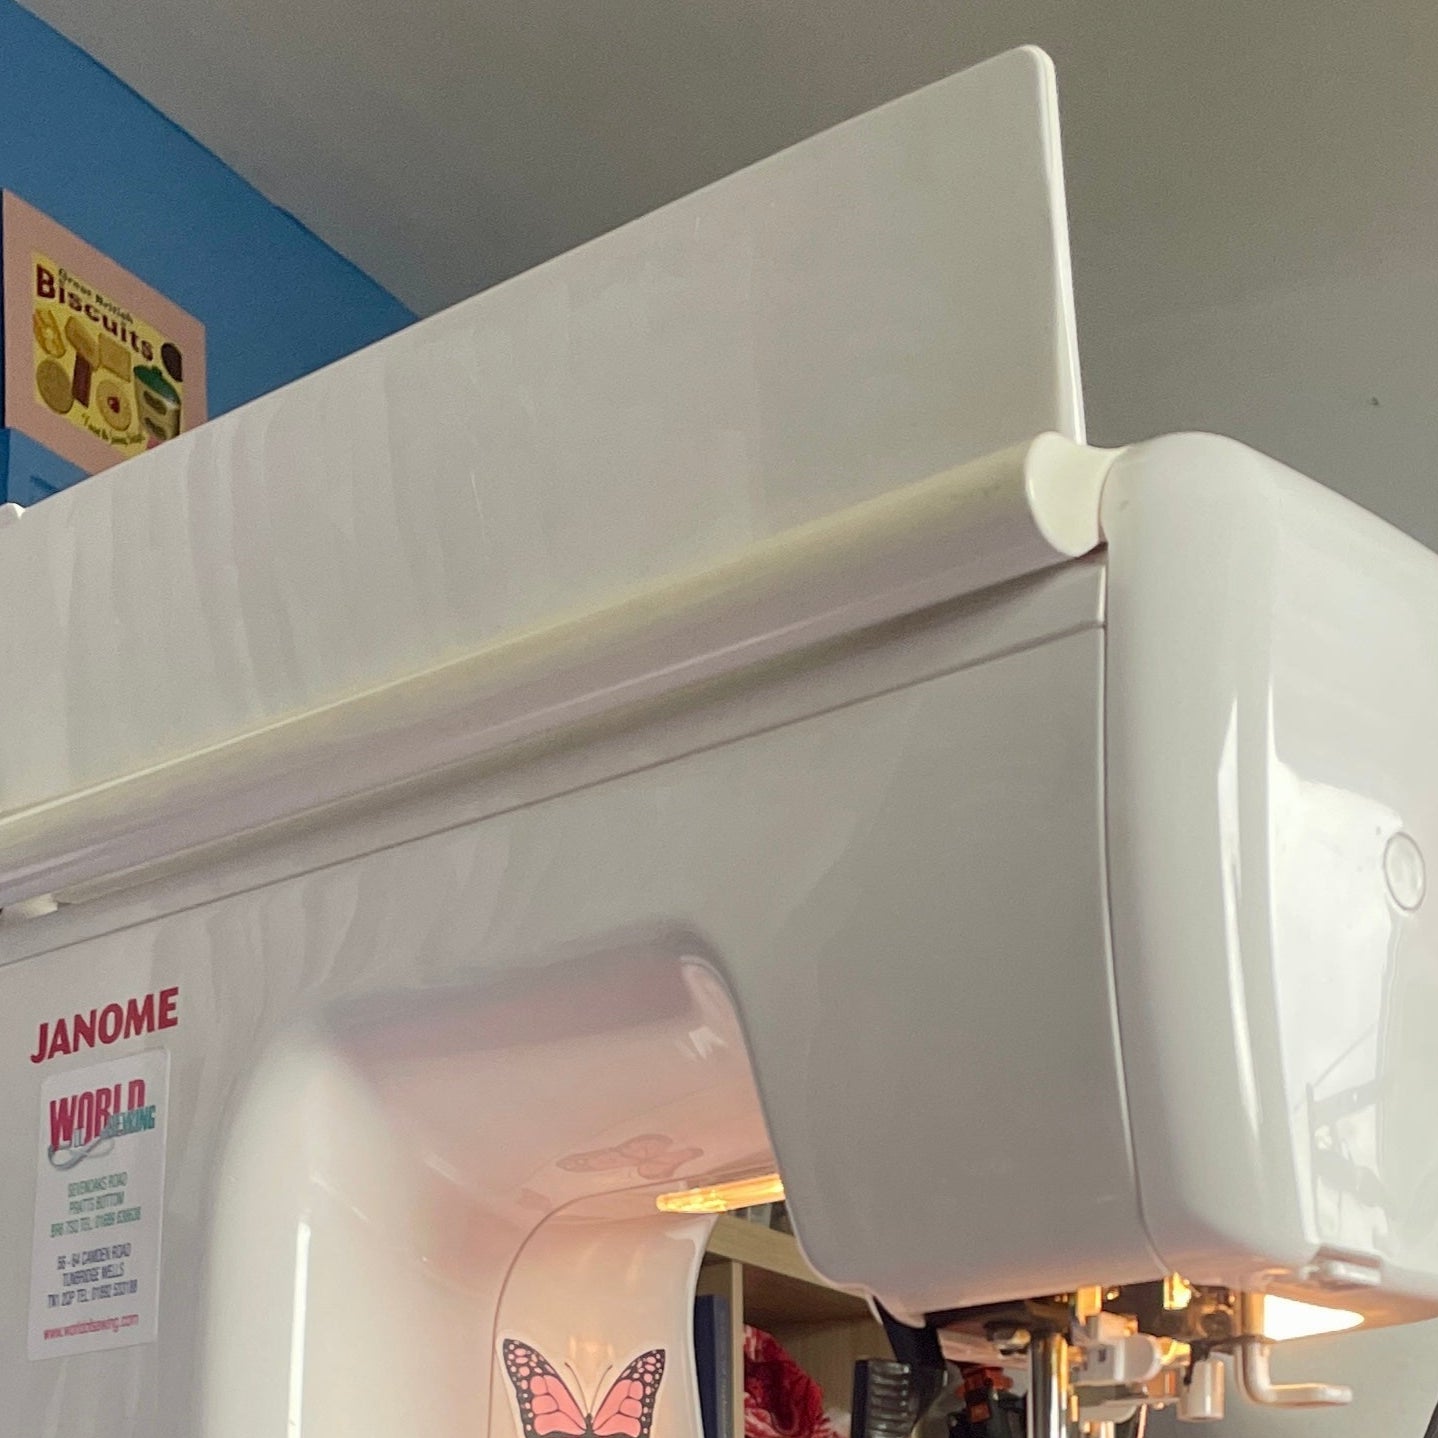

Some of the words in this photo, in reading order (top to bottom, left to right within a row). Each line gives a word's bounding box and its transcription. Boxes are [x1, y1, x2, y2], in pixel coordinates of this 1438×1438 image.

[36, 263, 154, 361] Biscuits
[30, 986, 180, 1064] JANOME
[50, 1078, 147, 1152] WORLD
[108, 1171, 128, 1188] ROAD
[101, 1261, 125, 1280] WELLS
[111, 1242, 132, 1259] ROAD
